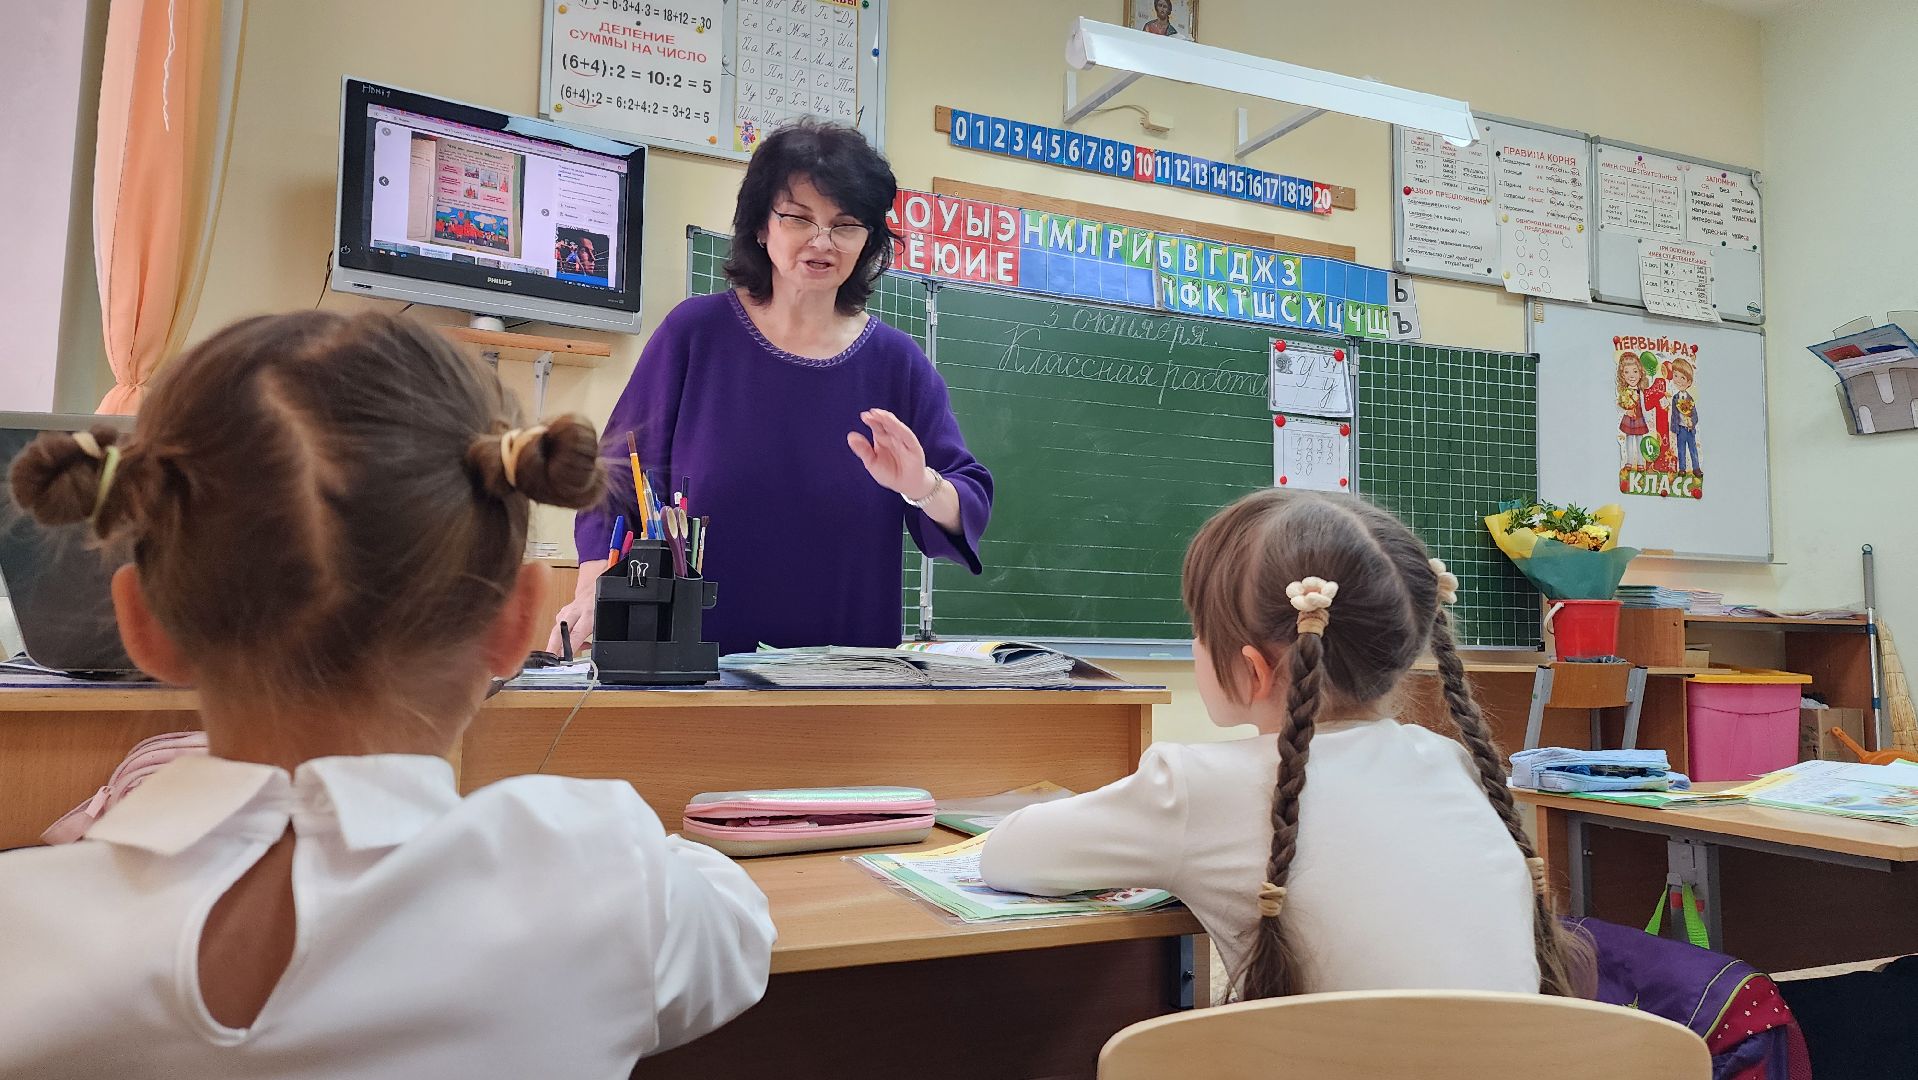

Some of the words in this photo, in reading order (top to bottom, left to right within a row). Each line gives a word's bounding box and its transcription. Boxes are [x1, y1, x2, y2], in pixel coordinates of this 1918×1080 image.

[663, 8, 689, 25] 18+12
[699, 16, 712, 29] 30
[599, 22, 675, 45] ДЕЛЕНИЕ
[569, 28, 627, 50] СУММЫ
[632, 42, 652, 55] НА
[656, 47, 707, 63] ЧИСЛО
[702, 79, 712, 94] 5
[672, 104, 691, 120] 3+2
[703, 111, 710, 124] 5
[956, 117, 966, 140] 0
[976, 120, 984, 144] 1
[994, 125, 1005, 148] 2
[1013, 127, 1024, 152] 3
[1031, 131, 1042, 155] 4
[1050, 135, 1061, 159] 5
[1069, 138, 1079, 162] 6
[1087, 142, 1097, 165] 7
[1104, 145, 1114, 169] 8
[1121, 149, 1131, 172] 9
[1137, 154, 1152, 177] 10
[1156, 156, 1170, 179] 11
[1175, 160, 1190, 183] 12
[1193, 163, 1208, 186] 13
[1211, 167, 1226, 190] 14
[1229, 170, 1244, 193] 15
[1247, 174, 1261, 197] 16
[1264, 178, 1279, 201] 17
[1281, 181, 1296, 203] 18
[1299, 185, 1312, 208] 19
[1315, 187, 1331, 209] 20
[1503, 146, 1546, 160] ПРАВИЛА
[1547, 154, 1576, 166] КОРНЯ
[487, 276, 513, 287] PHILIPS
[998, 322, 1158, 387] Классная
[1629, 472, 1692, 496] КЛАСС
